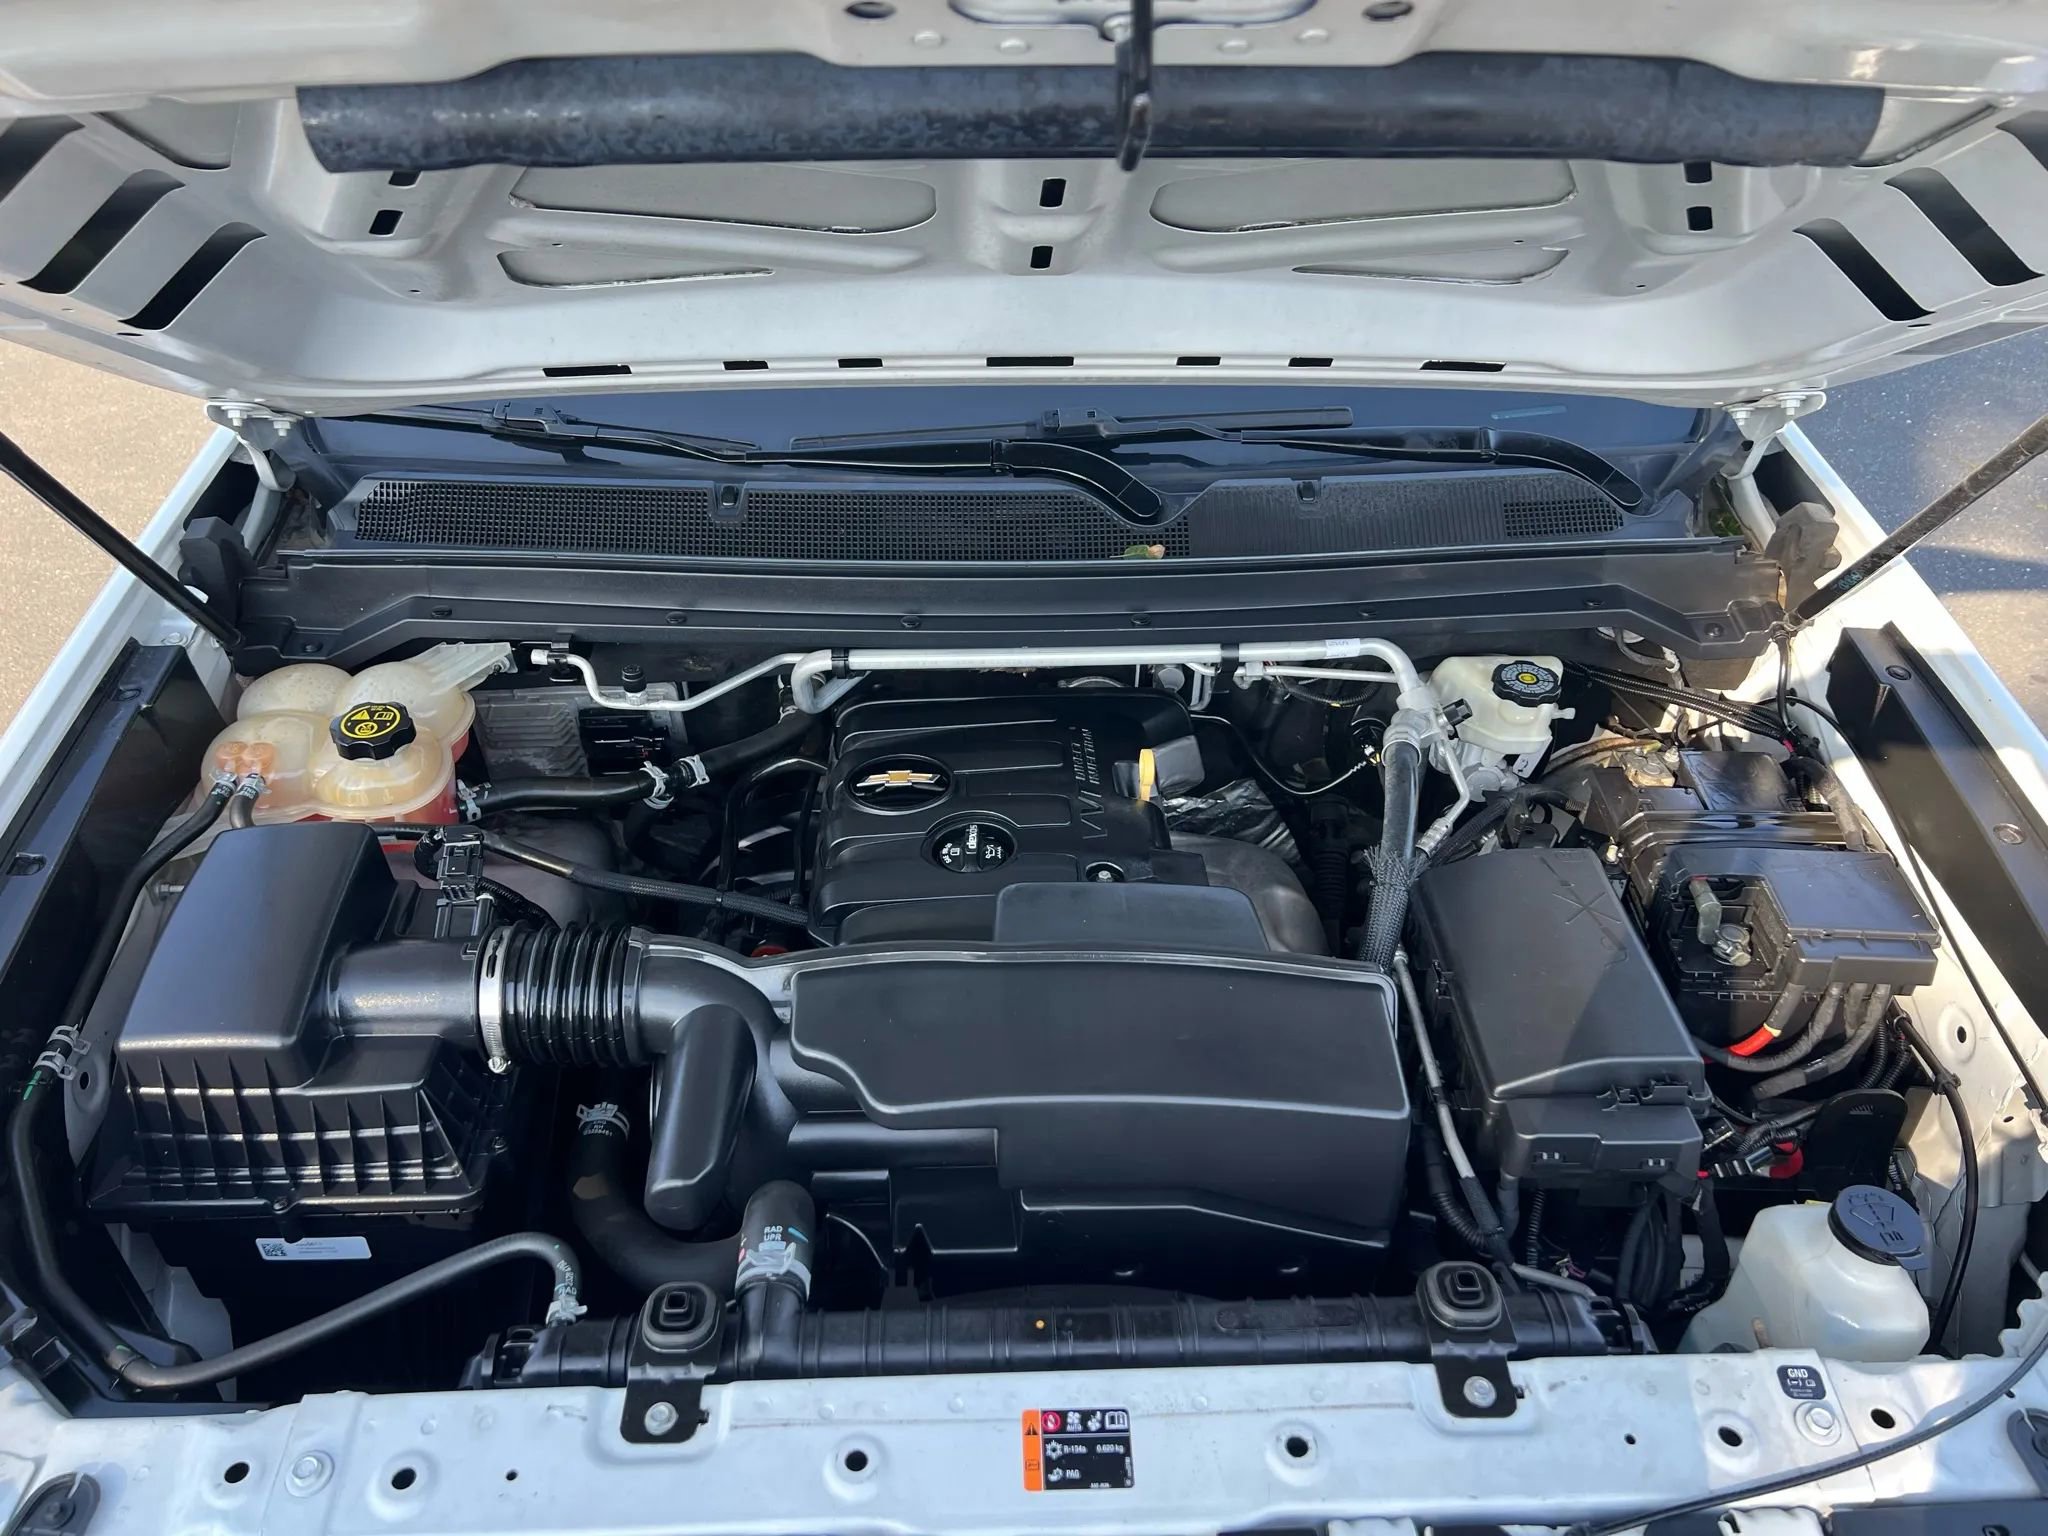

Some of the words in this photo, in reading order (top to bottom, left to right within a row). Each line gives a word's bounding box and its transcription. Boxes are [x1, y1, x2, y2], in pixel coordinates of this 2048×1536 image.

[966, 824, 978, 849] dexos
[763, 1225, 783, 1234] RAD
[763, 1233, 782, 1241] UPR
[1787, 1368, 1808, 1378] GND
